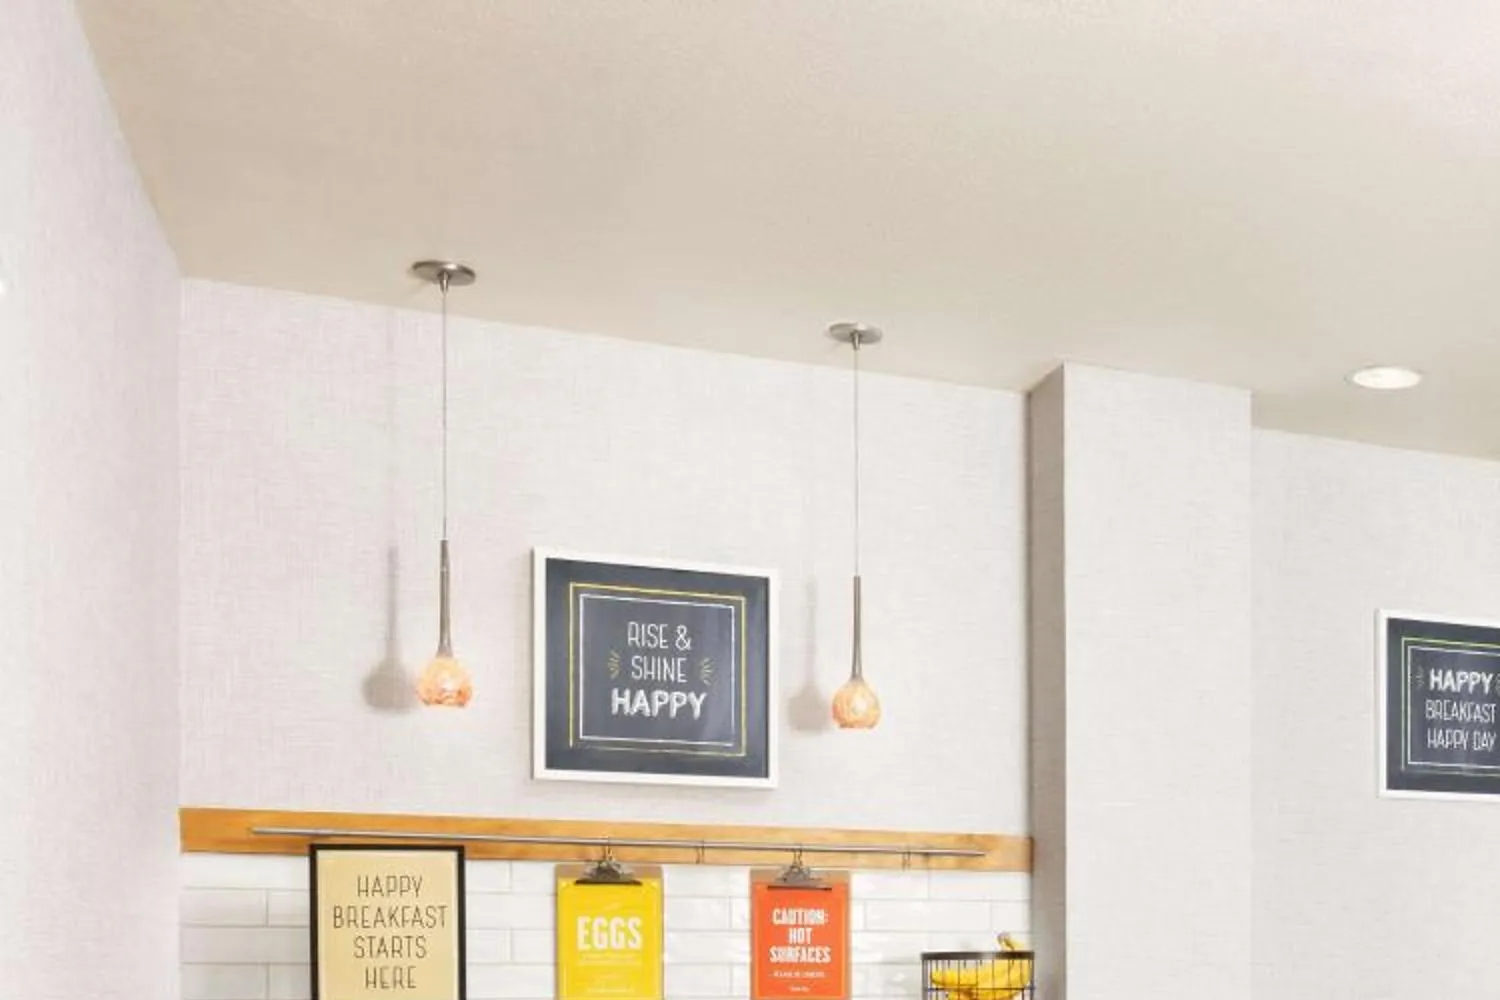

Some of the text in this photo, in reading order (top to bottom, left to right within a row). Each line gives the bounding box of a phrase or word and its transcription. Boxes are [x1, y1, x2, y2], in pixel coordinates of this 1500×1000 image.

[627, 620, 693, 651] RISE &
[630, 655, 688, 683] SHINE
[1429, 667, 1494, 695] HAPPY
[610, 687, 708, 720] HAPPY
[1425, 698, 1498, 724] BREAKFAST
[1427, 729, 1498, 752] HAPPY DAY
[357, 875, 424, 897] HAPPY
[333, 905, 448, 929] BREAKFAST
[577, 915, 642, 951] EGGS
[788, 927, 813, 945] HOT
[353, 935, 428, 959] STARTS
[769, 946, 832, 963] SURFACES
[365, 966, 417, 989] HERE
